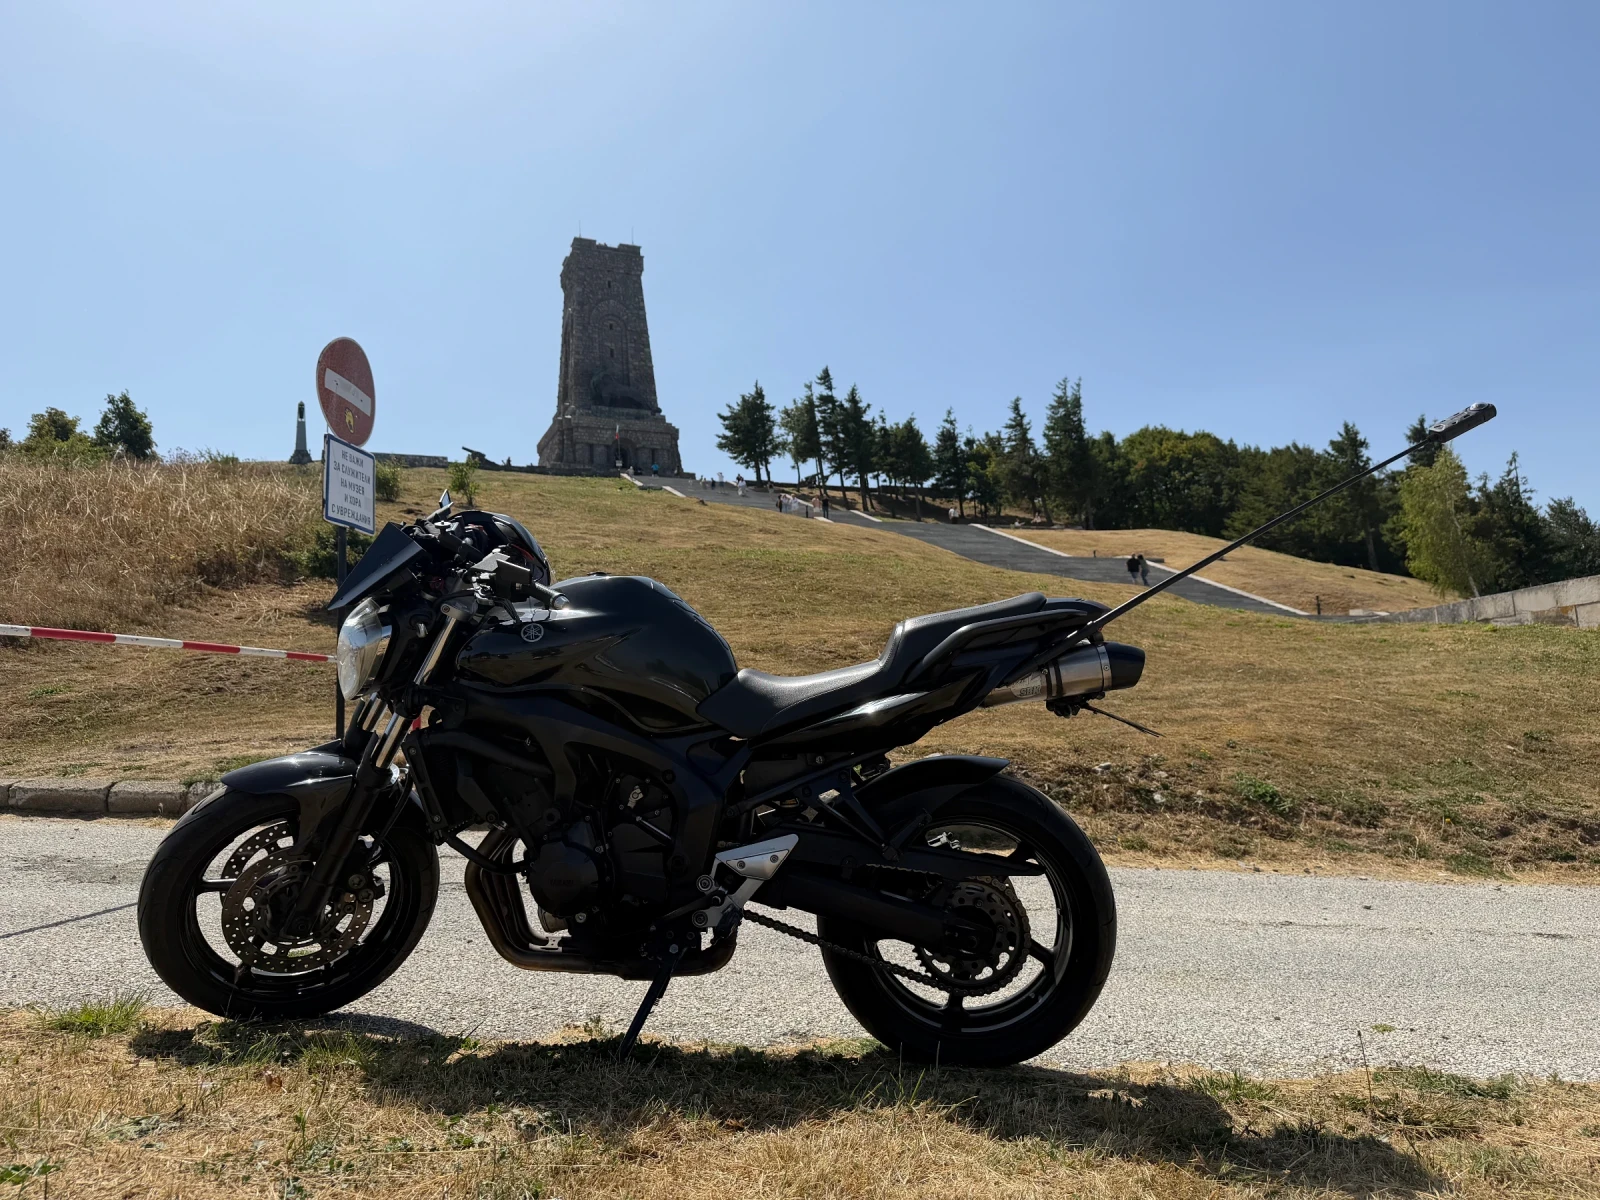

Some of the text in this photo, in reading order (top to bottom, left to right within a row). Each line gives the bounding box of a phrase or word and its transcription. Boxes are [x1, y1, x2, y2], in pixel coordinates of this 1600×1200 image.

[341, 449, 364, 468] НЕ ВАЖИ
[333, 460, 371, 485] ЗА СЛУЖИТЕЛИ
[340, 477, 365, 496] НА МУЗЕЯ
[344, 493, 362, 508] И ХОРА
[331, 503, 371, 525] С УВРЕЖДАНИЯ
[1019, 684, 1041, 697] SBK
